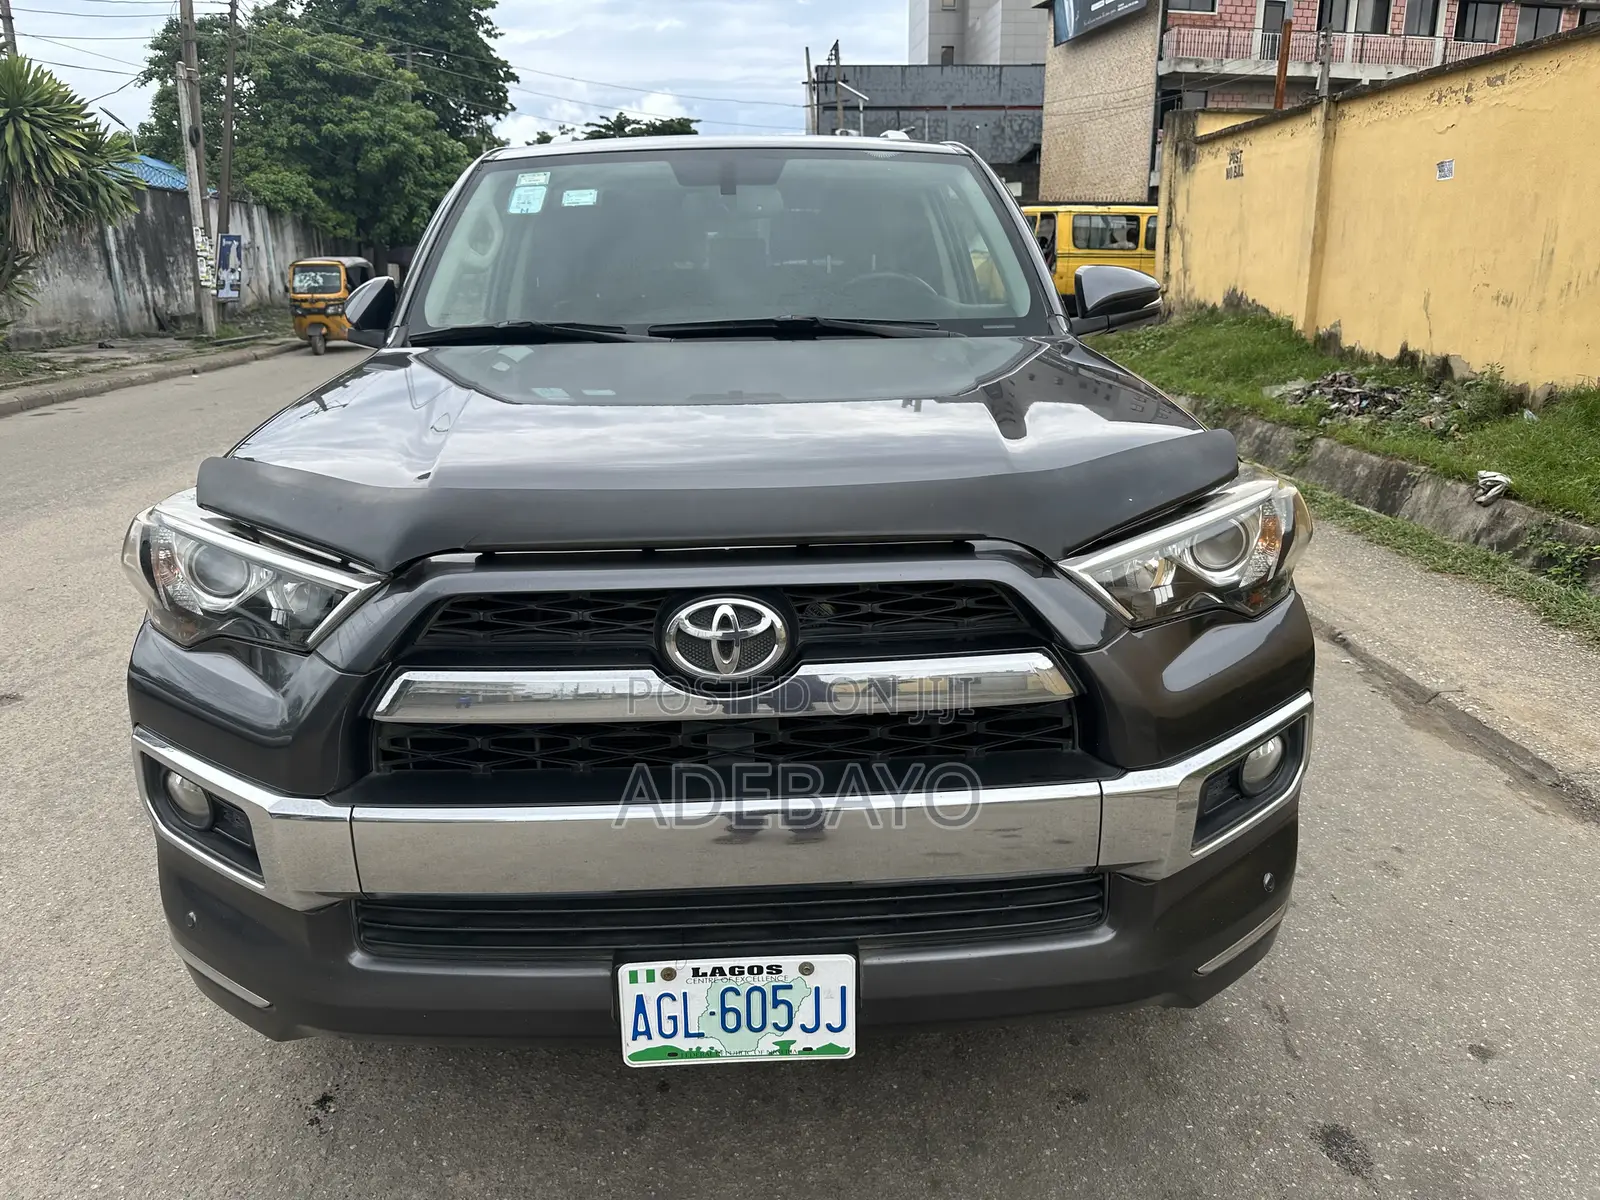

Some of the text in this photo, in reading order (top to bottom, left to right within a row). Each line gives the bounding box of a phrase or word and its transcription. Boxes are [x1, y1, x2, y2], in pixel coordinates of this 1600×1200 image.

[691, 964, 783, 978] LAGOS
[685, 976, 717, 985] CENTRE
[735, 974, 789, 983] EXCELLENCE
